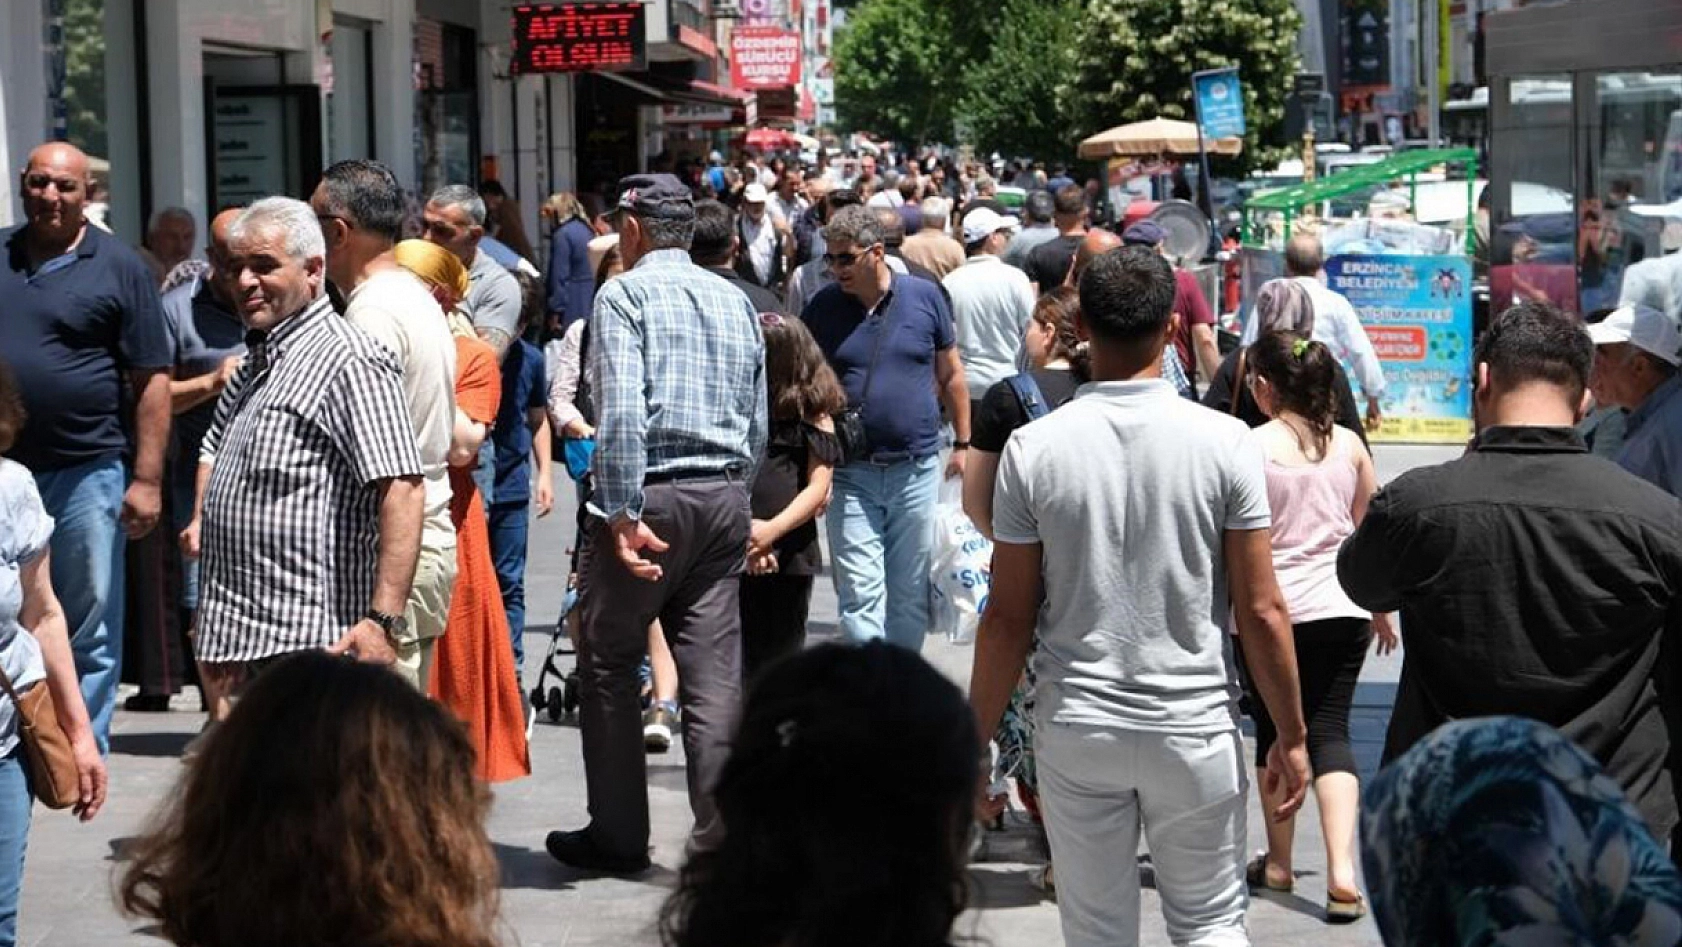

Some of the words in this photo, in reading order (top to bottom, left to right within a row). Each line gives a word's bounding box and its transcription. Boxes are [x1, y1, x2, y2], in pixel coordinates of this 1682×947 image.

[531, 43, 632, 66] OLSUN
[736, 48, 797, 63] SÜRÜCÜ
[741, 64, 790, 77] KURSU
